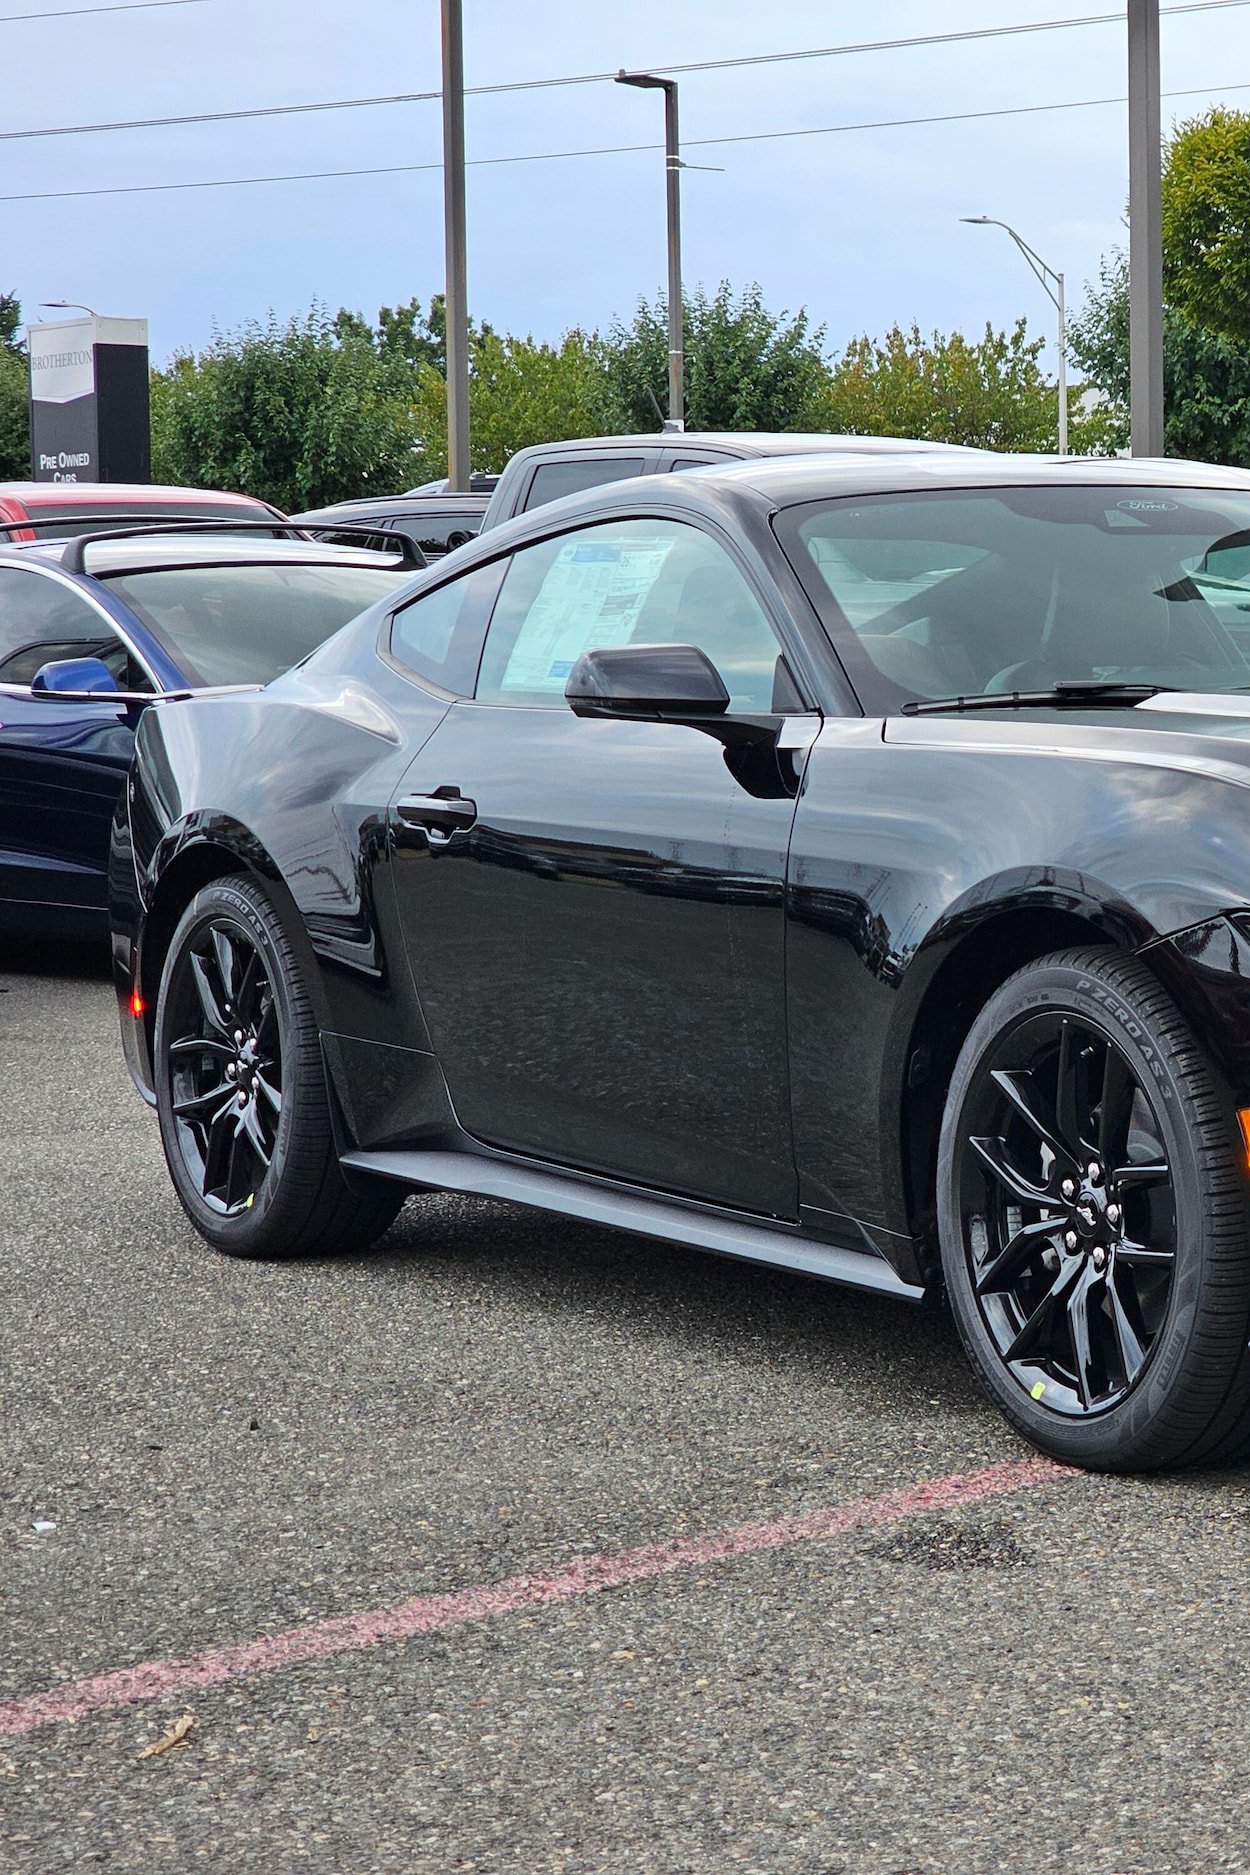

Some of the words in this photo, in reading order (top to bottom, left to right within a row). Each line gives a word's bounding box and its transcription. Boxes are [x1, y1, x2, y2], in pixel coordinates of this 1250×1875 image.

[32, 350, 92, 371] BROTHERTON
[59, 452, 90, 467] OWNED
[221, 892, 249, 914] ZERO
[1076, 980, 1091, 990] P
[1091, 987, 1142, 1038] ZERO
[1139, 1045, 1164, 1078] AS
[1160, 1084, 1173, 1099] 3
